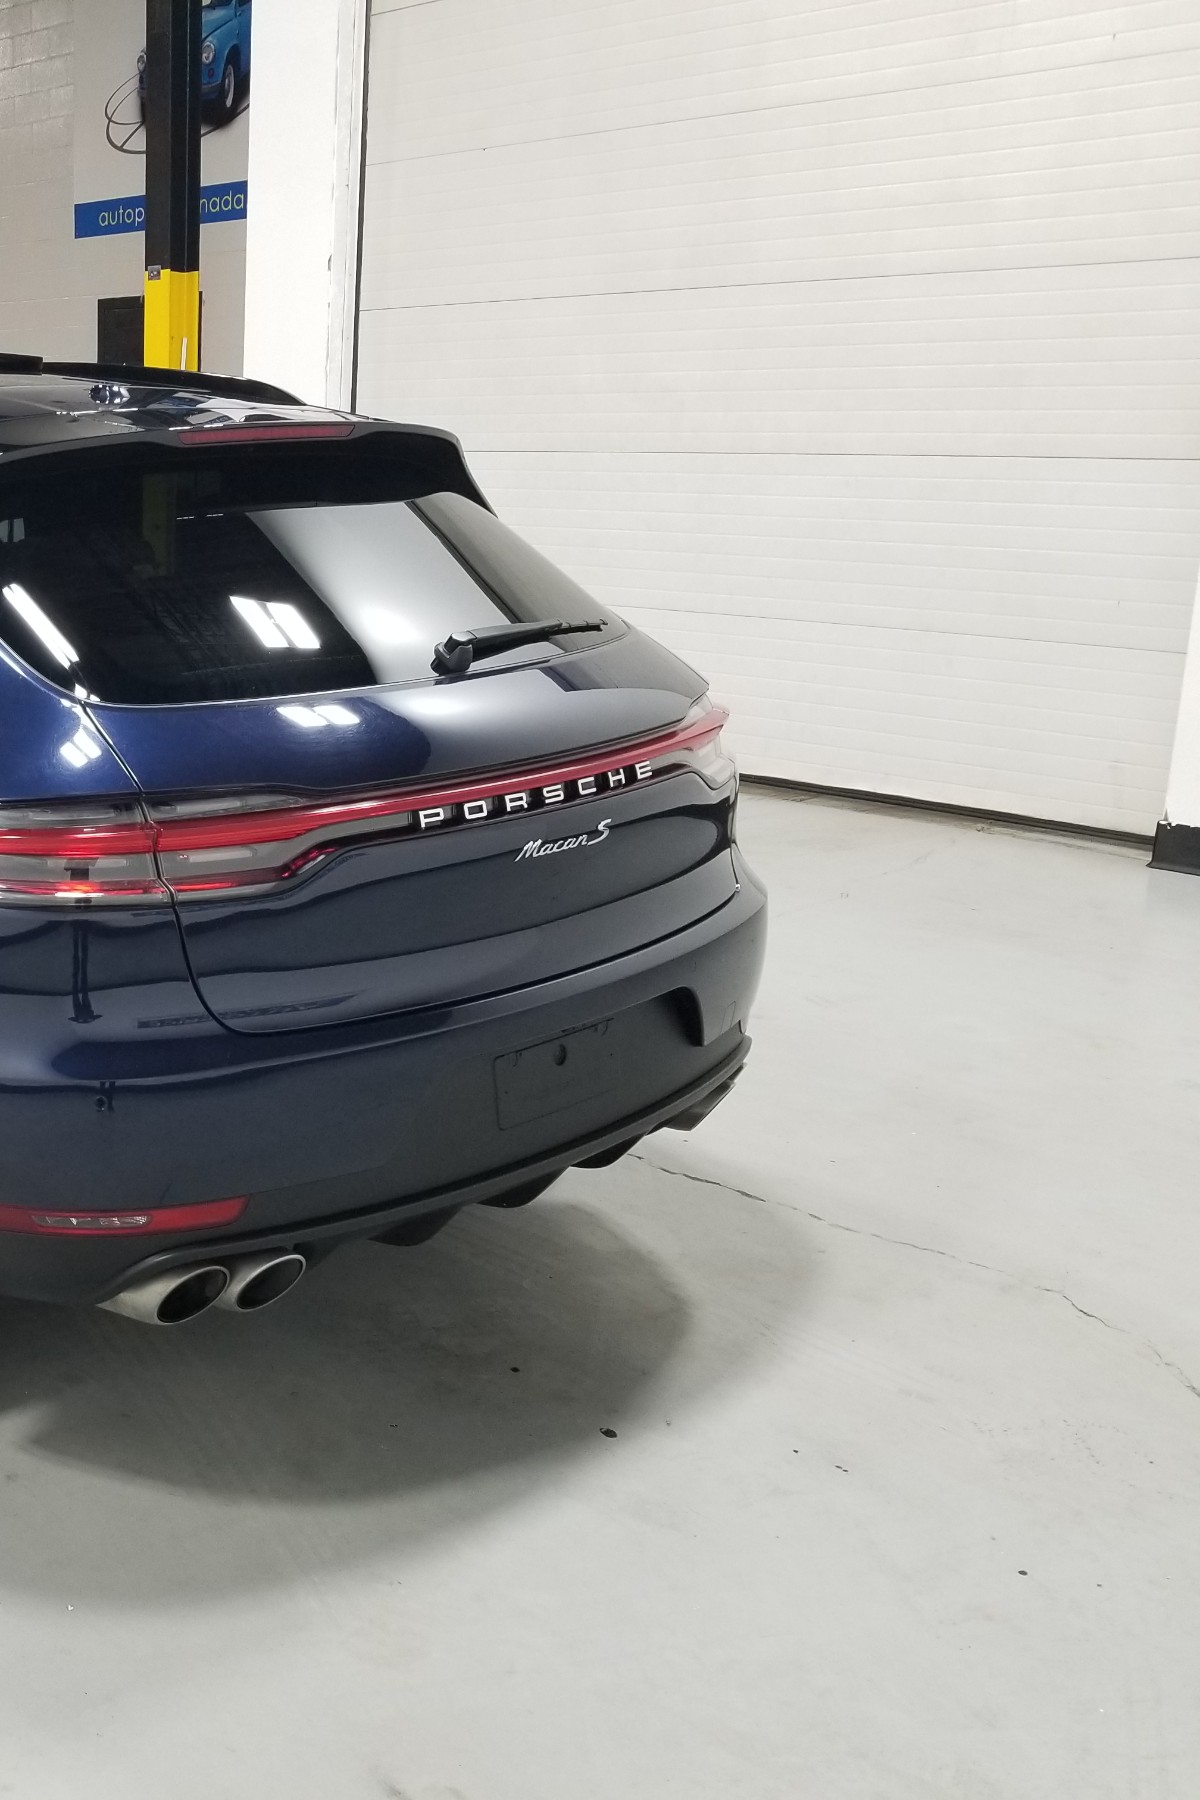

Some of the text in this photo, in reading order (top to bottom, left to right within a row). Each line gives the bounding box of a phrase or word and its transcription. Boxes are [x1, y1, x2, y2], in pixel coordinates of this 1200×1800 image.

[419, 760, 653, 829] PORSCHE
[514, 818, 613, 862] Macan S
